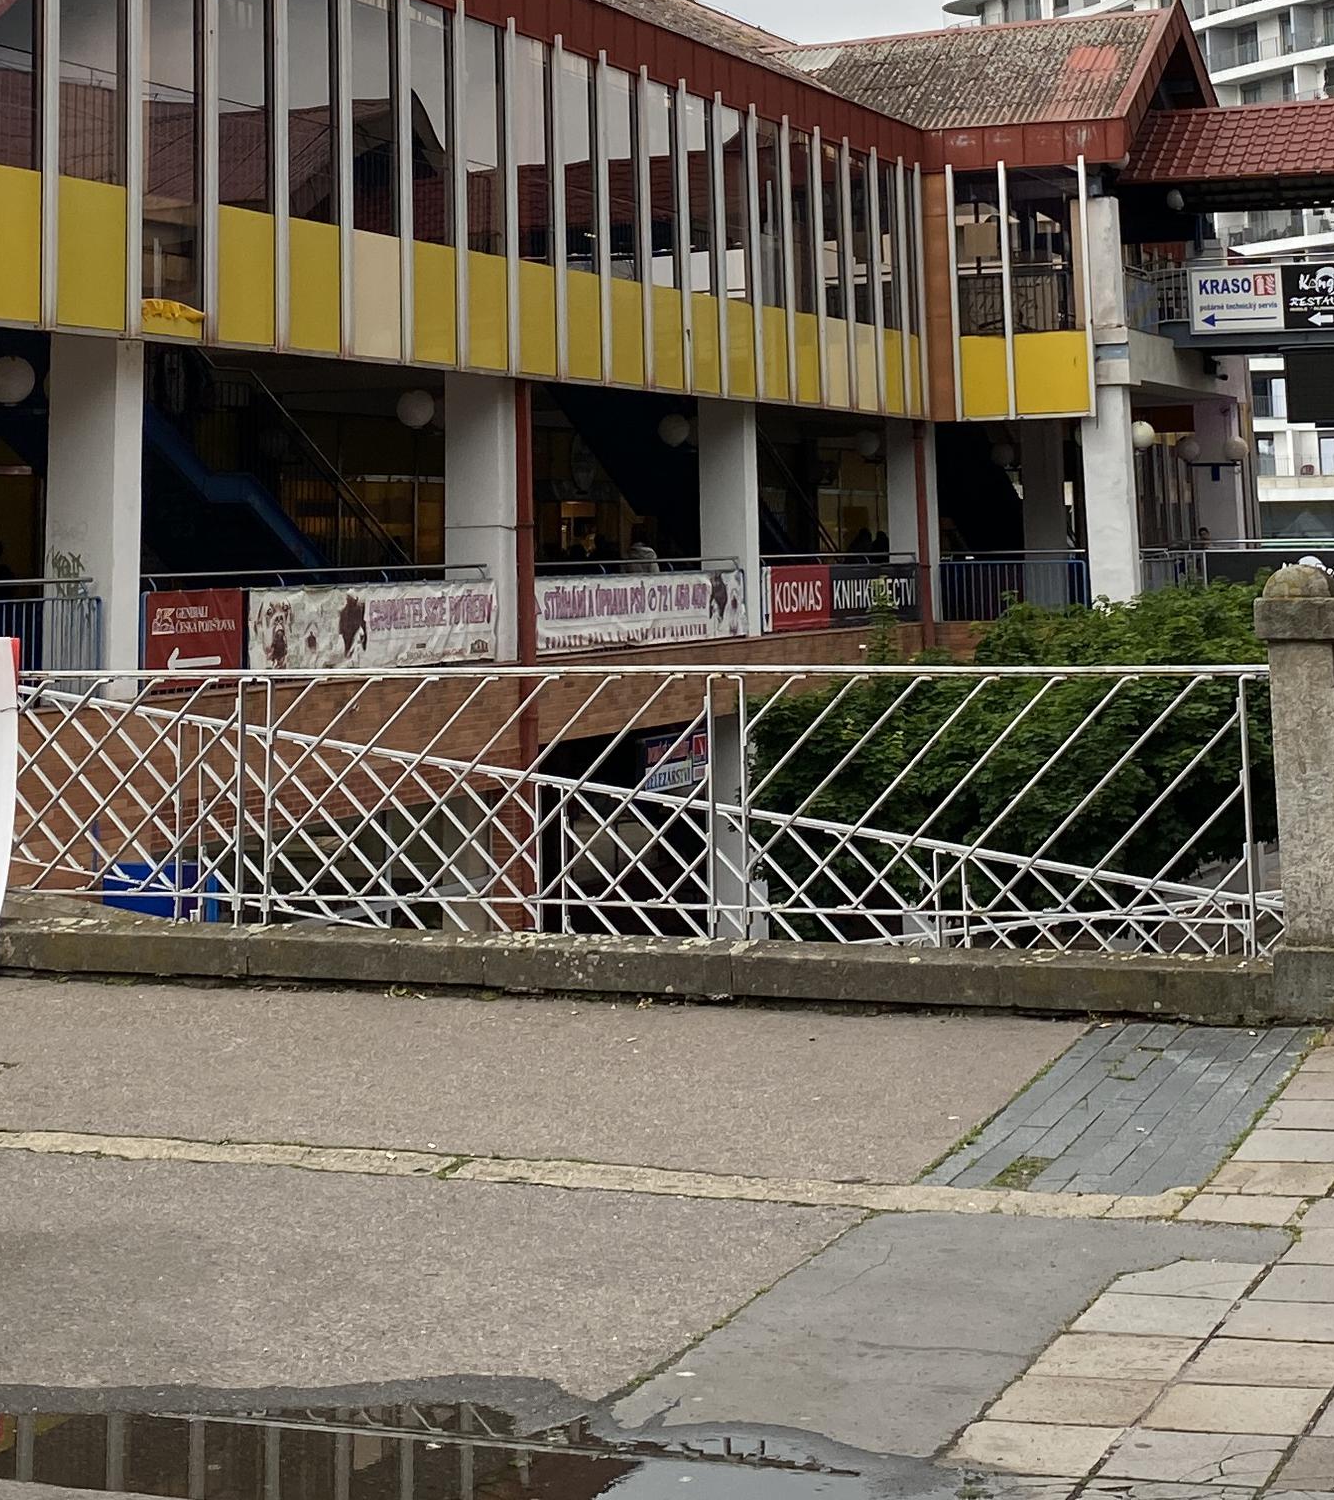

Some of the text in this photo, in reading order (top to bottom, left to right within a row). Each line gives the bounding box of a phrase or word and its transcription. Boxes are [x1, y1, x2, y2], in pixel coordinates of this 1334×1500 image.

[1198, 277, 1252, 295] KRASO
[1258, 301, 1278, 309] servis
[774, 580, 823, 614] KOSMAS
[175, 605, 209, 619] GENERALI
